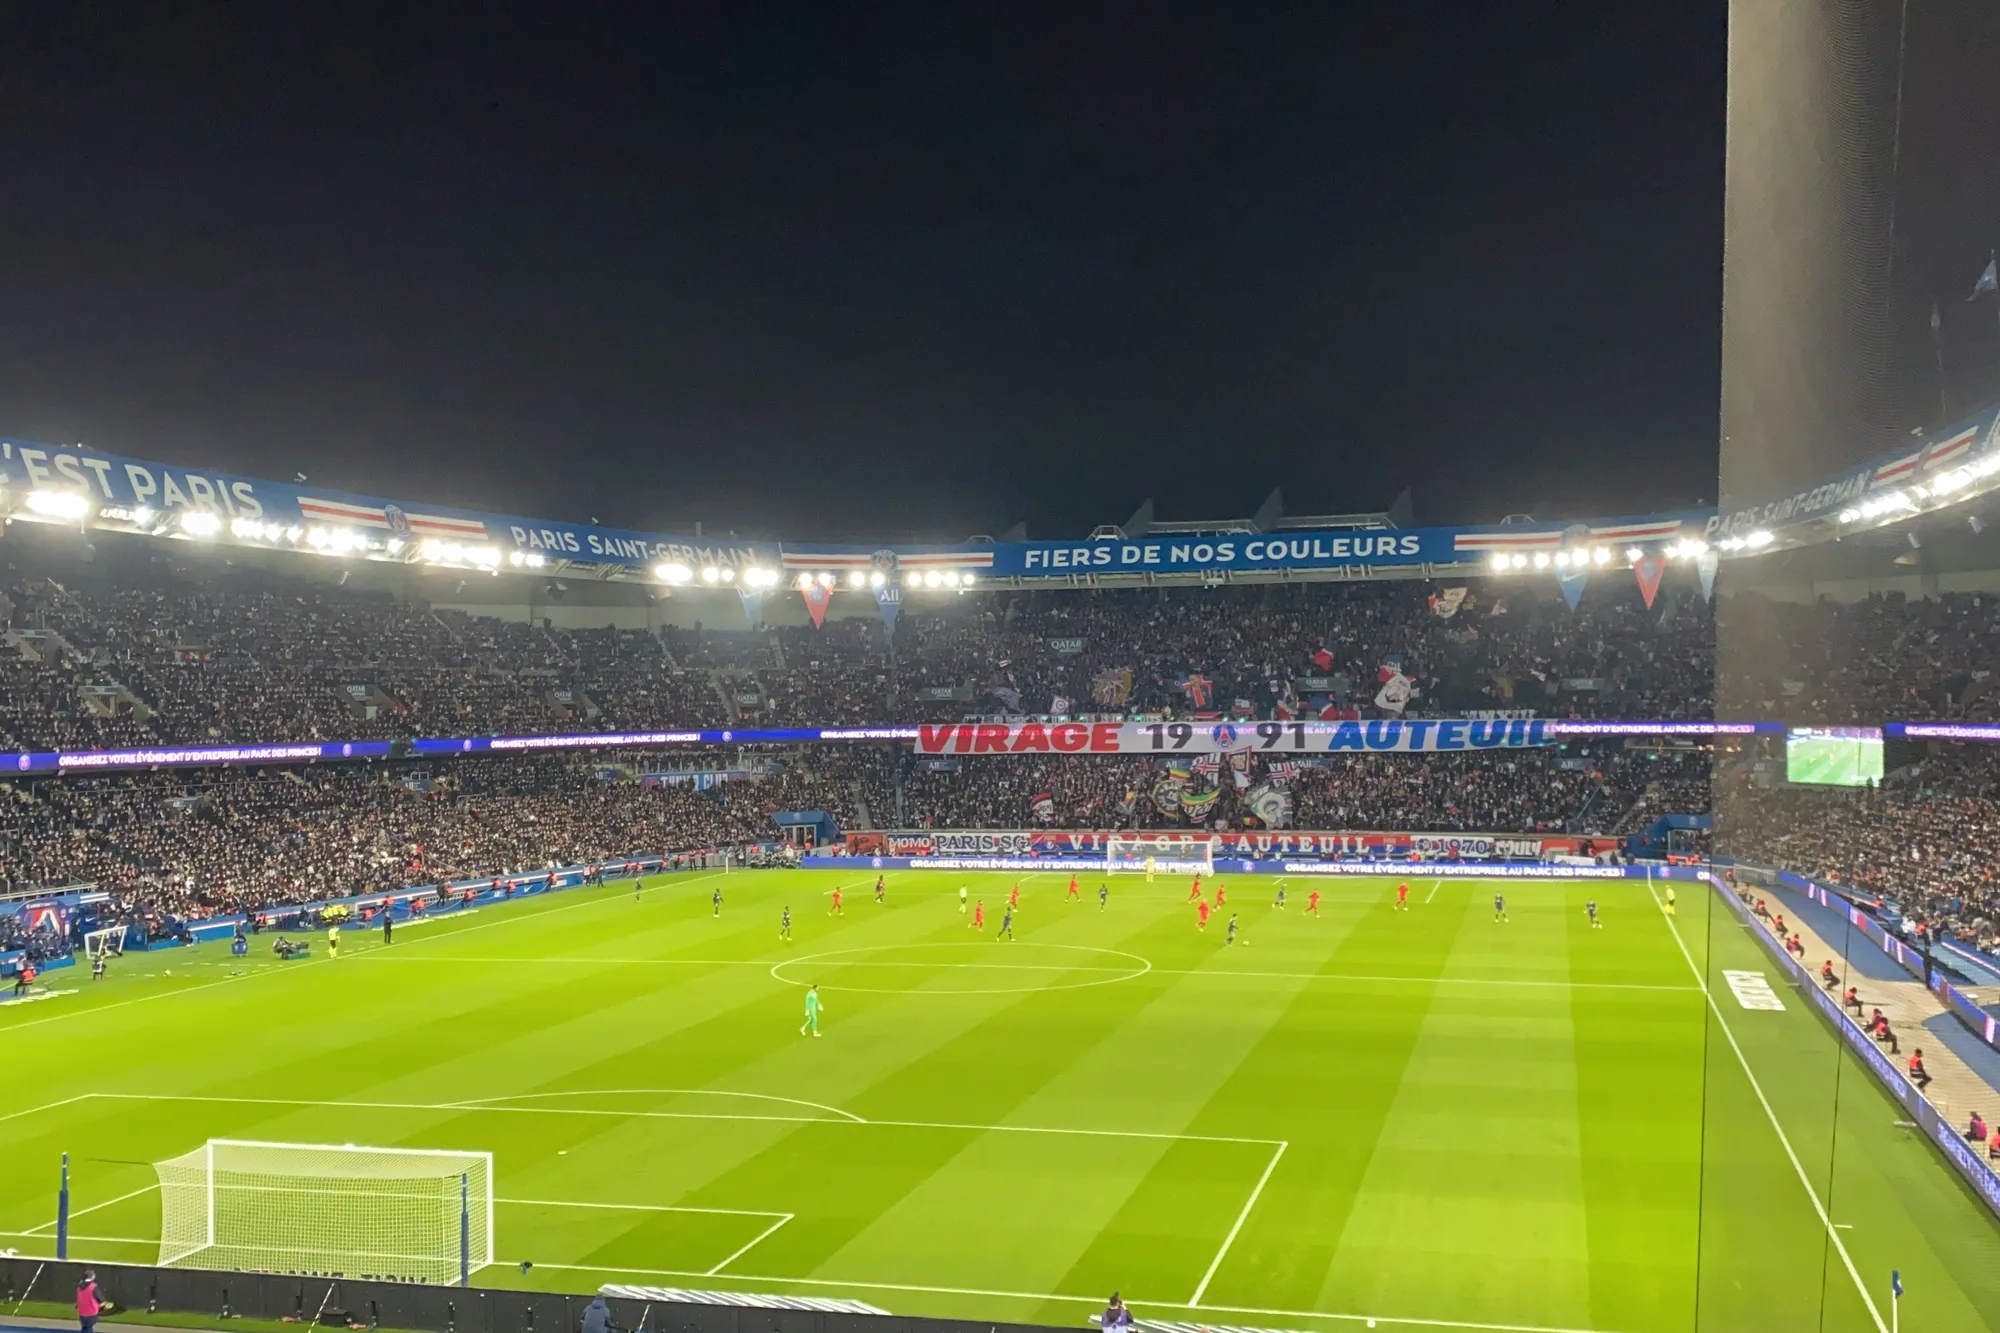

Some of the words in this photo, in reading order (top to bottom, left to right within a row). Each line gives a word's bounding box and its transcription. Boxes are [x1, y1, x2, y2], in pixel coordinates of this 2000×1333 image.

[124, 464, 263, 518] PARIS
[1704, 506, 1760, 538] PARIS
[510, 526, 581, 552] PARIS
[588, 535, 757, 567] SAINT-GERMAIN
[1025, 547, 1111, 568] FIERS
[1121, 545, 1161, 564] DE
[1170, 543, 1235, 563] NOS
[1245, 535, 1420, 561] COULEURS
[921, 722, 1124, 752] VIRAGE
[1146, 723, 1193, 749] 19
[1257, 723, 1305, 749] 91
[1328, 720, 1558, 750] AUTEUIL
[1664, 725, 1675, 733] AU
[1676, 725, 1699, 733] PARC
[59, 755, 107, 766] ORGANISEZ
[108, 753, 137, 764] VOTRE
[240, 749, 250, 758] AU
[251, 749, 272, 758] PARC
[272, 748, 287, 757] DES
[287, 747, 317, 757] PRINCES
[889, 837, 930, 849] MOMO
[934, 835, 993, 850] PARIS
[1001, 835, 1028, 850] SG
[1236, 836, 1370, 853] AUTEUIL
[910, 859, 960, 868] ORGANISEZ
[961, 859, 990, 868] VOTRE
[991, 858, 1043, 868] ÉVÉNEMENT
[1285, 863, 1341, 872] ORGANISEZ
[1342, 864, 1374, 873] VOTRE
[1375, 863, 1434, 874] ÉVÉNEMENT
[1435, 866, 1507, 875] D'ENTREPRISE
[1507, 867, 1522, 875] AU
[1524, 867, 1552, 876] PARC
[1553, 868, 1574, 876] DES
[1575, 868, 1620, 877] PRINCES
